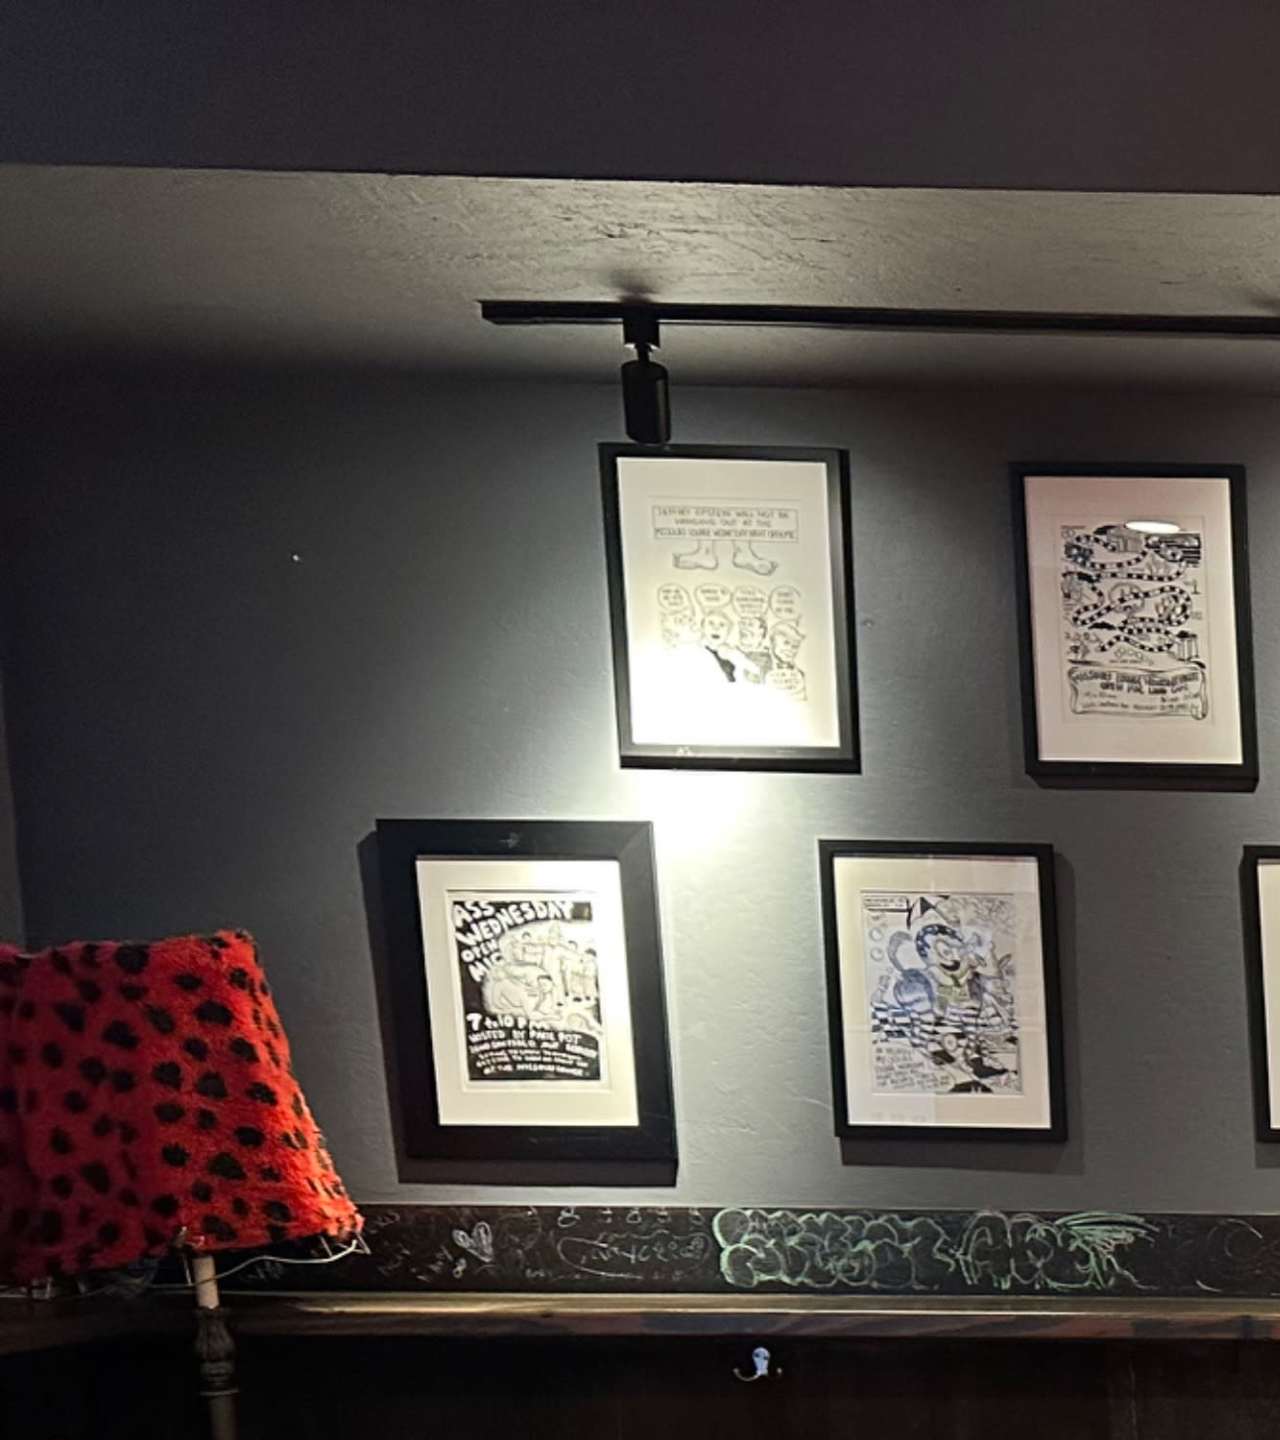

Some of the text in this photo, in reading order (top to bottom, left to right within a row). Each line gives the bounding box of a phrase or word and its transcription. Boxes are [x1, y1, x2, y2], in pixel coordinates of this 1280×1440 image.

[453, 901, 496, 927] ASS
[456, 901, 573, 945] WEDNESDAY
[461, 937, 499, 962] OPEN
[466, 1012, 482, 1031] 7
